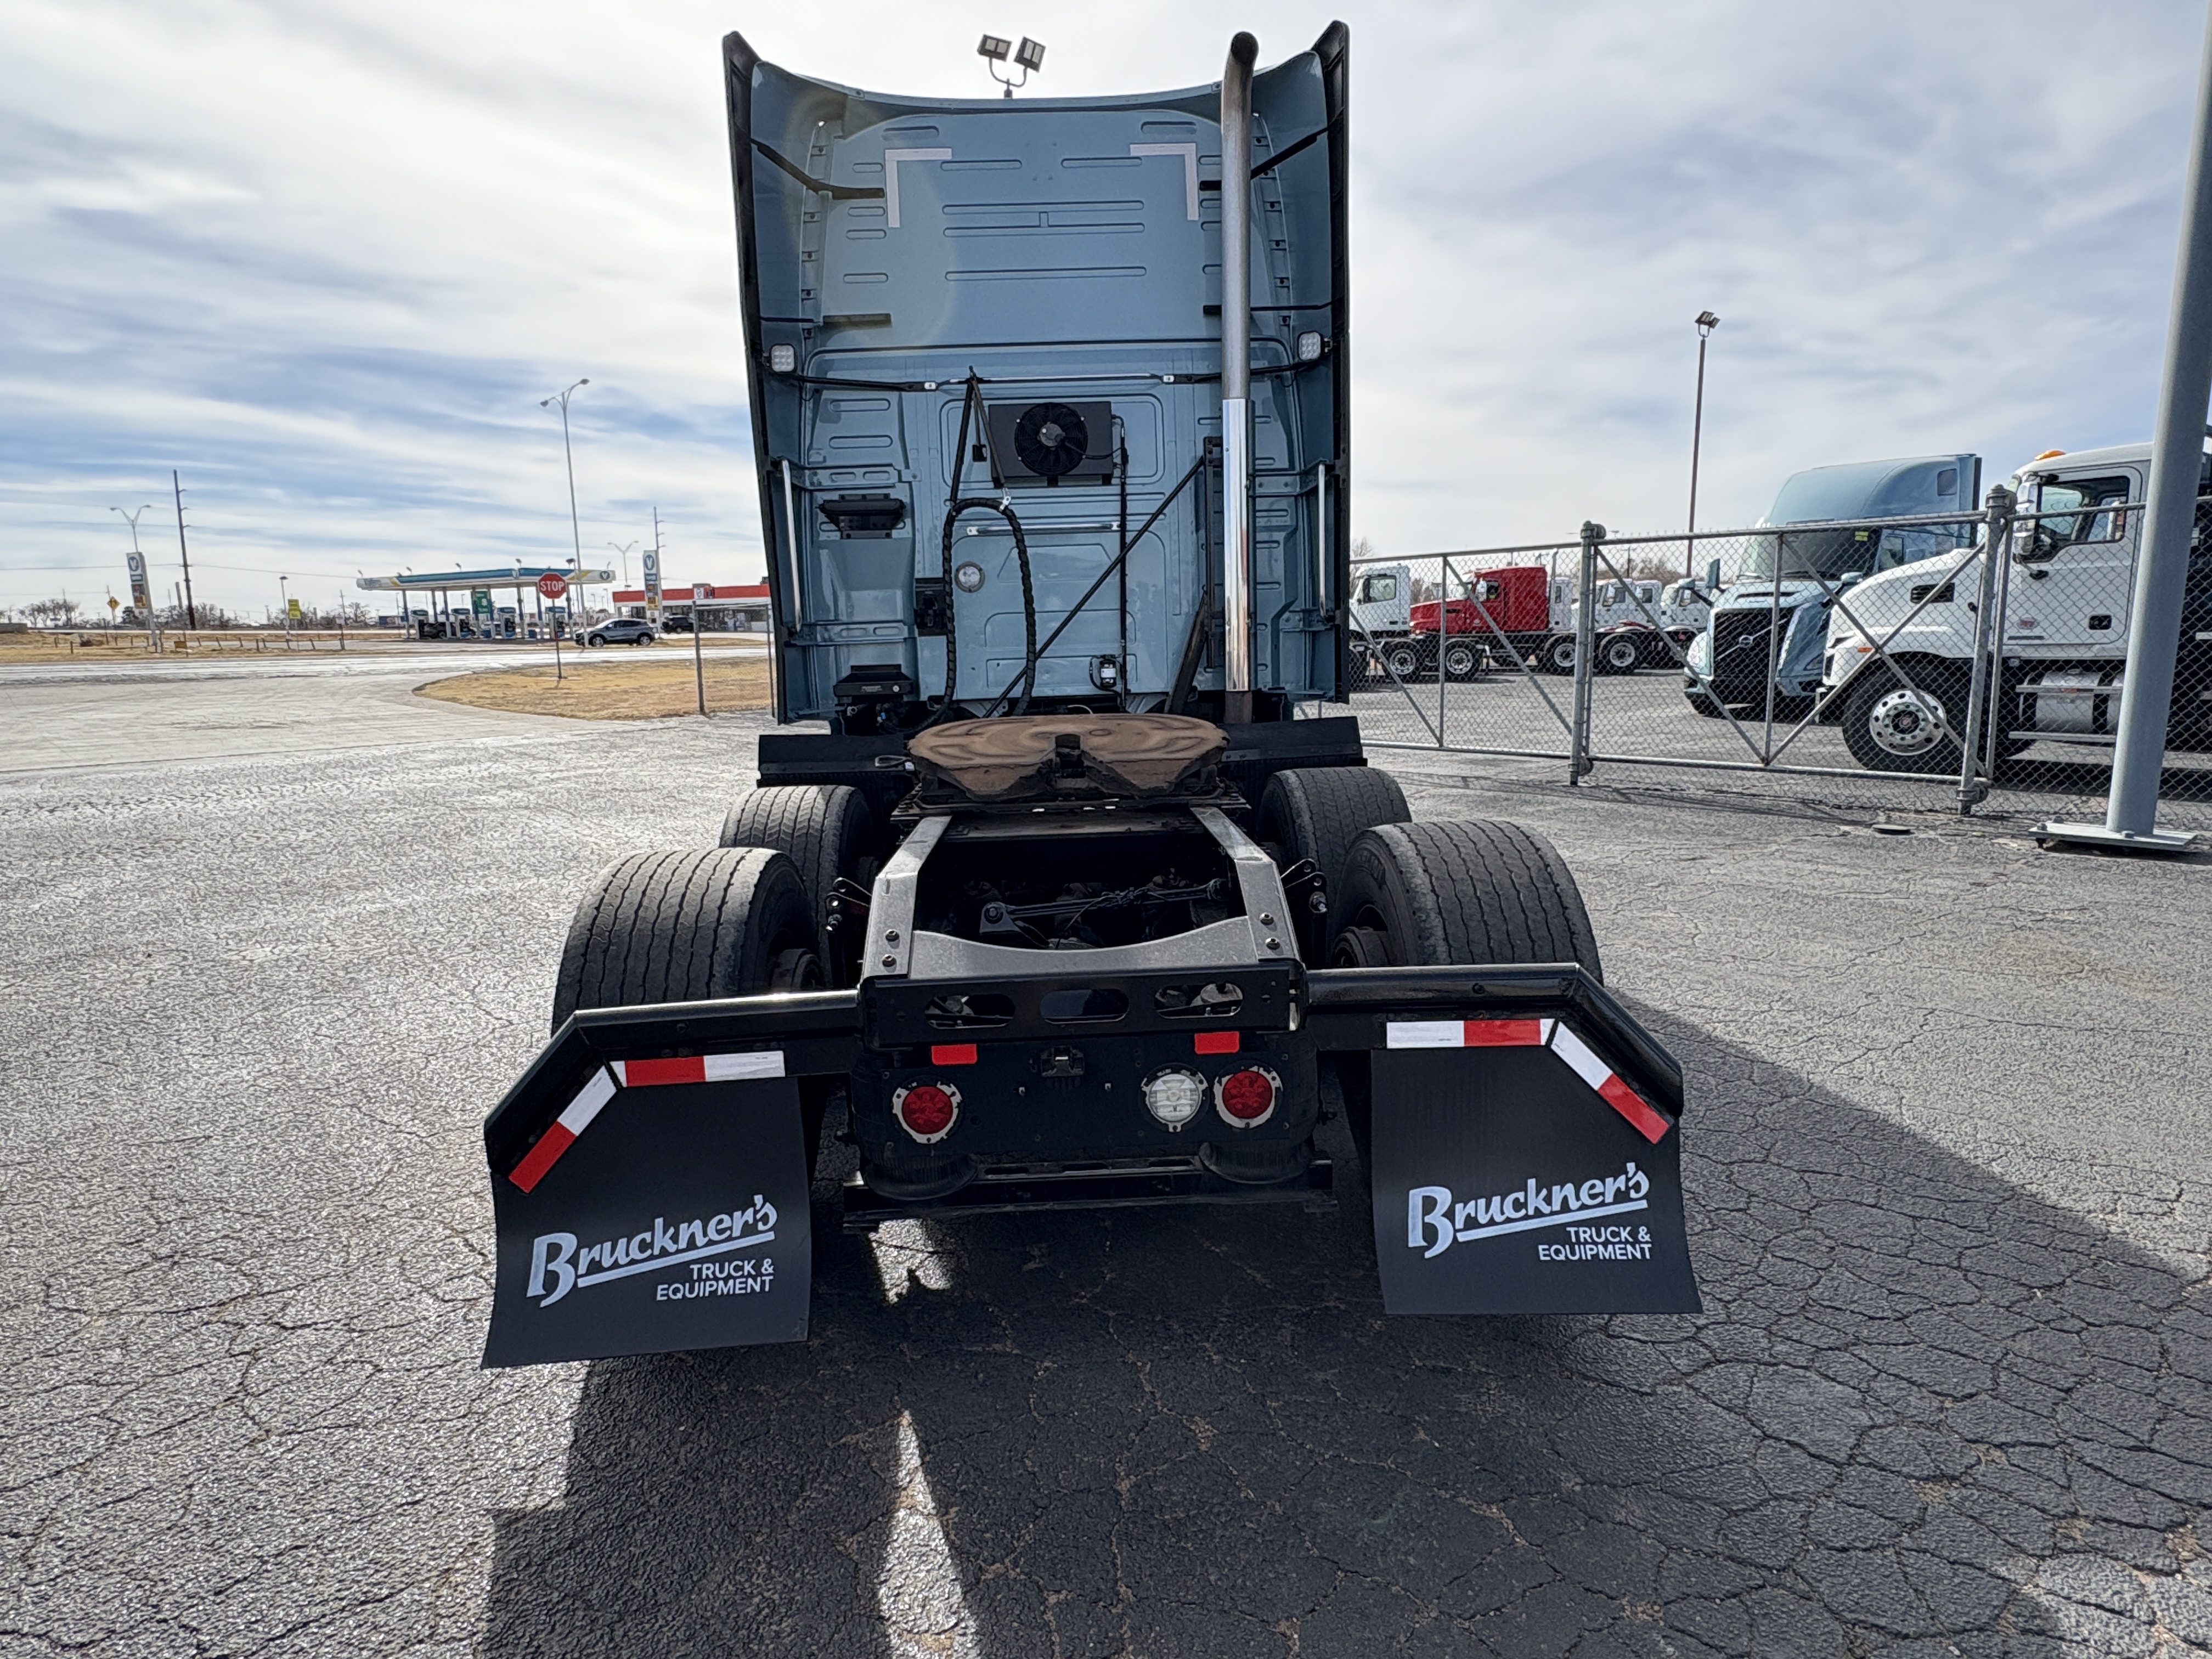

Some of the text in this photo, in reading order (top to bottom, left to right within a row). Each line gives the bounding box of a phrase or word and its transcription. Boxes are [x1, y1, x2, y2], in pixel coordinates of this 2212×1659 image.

[540, 580, 565, 592] STOP
[1408, 1162, 1650, 1259] Bruckner's
[1566, 1226, 1651, 1243] TRUCK &
[526, 1194, 778, 1308] Bruckner's
[1538, 1243, 1652, 1261] EQUIPMENT
[689, 1258, 774, 1280] TRUCK &
[656, 1276, 774, 1300] EQUIPMENT
